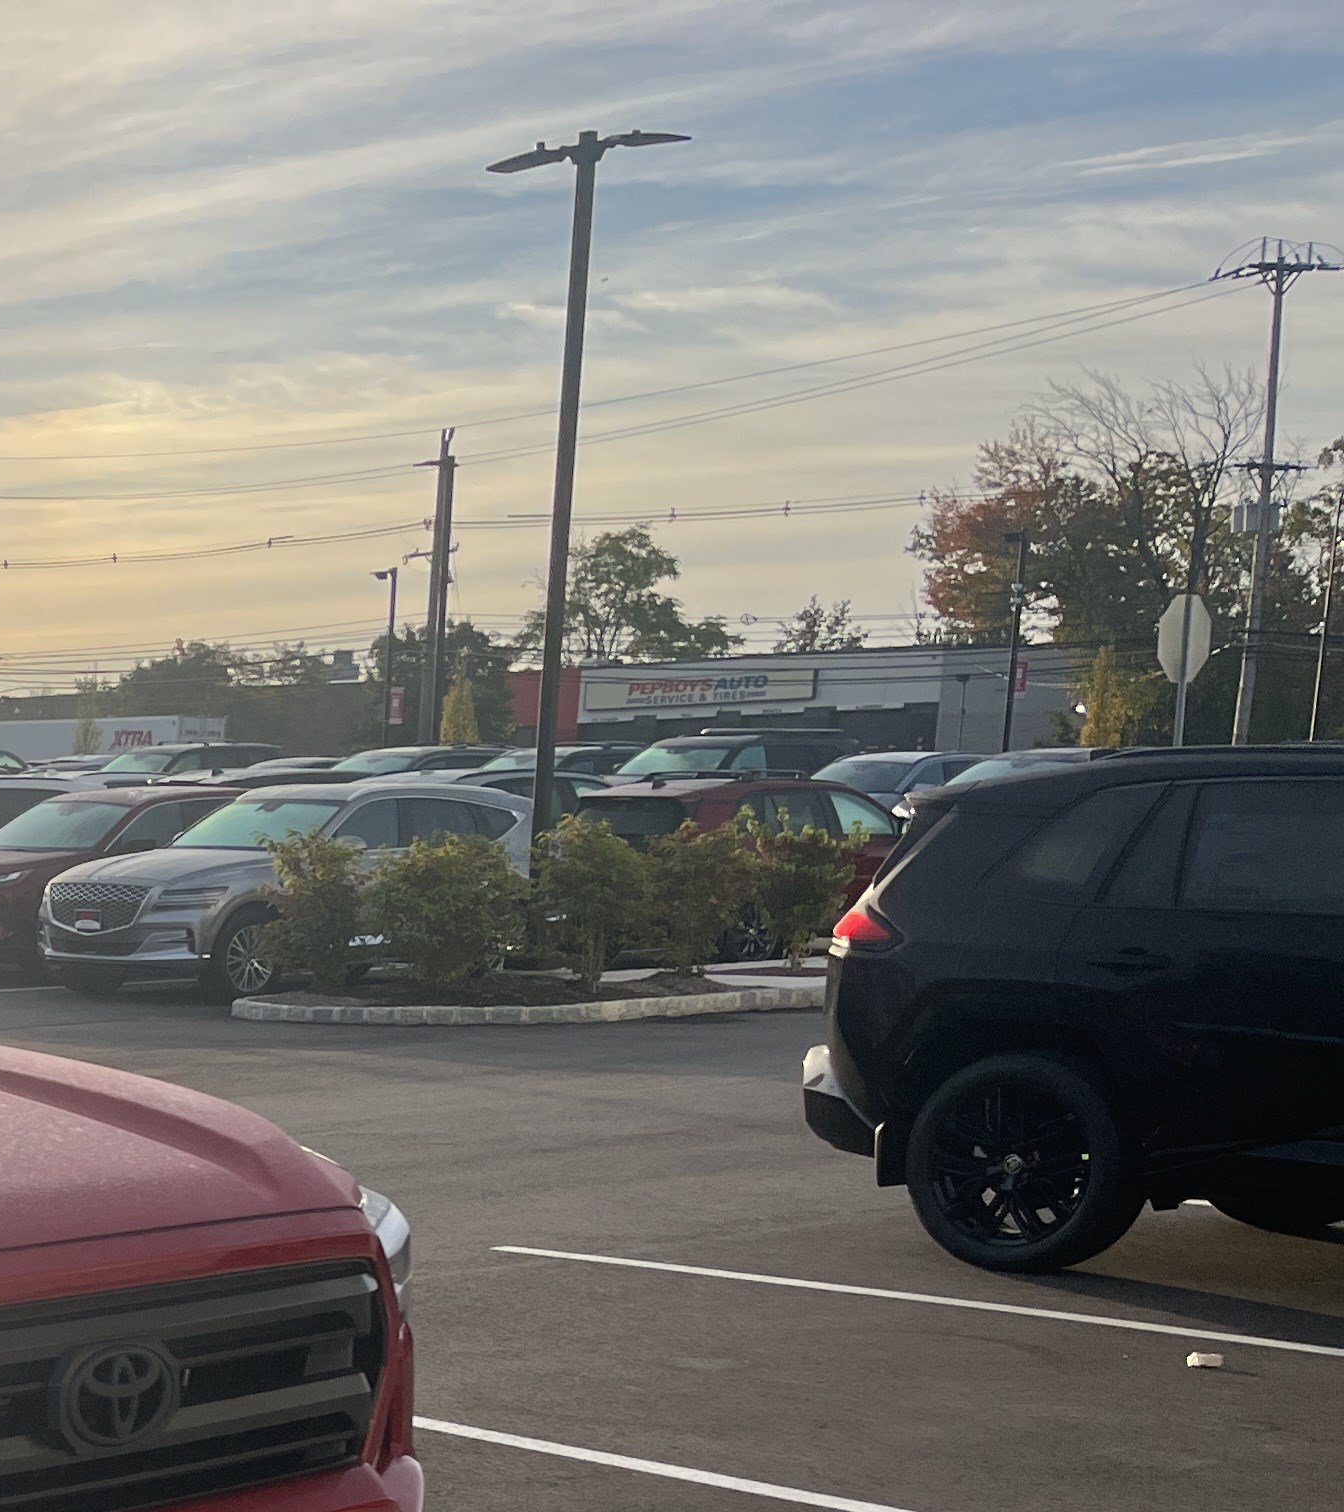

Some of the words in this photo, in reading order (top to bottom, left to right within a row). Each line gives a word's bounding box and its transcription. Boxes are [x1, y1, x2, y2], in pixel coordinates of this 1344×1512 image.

[714, 675, 769, 691] AUTO
[644, 693, 694, 705] SERVICE
[699, 692, 708, 702] &
[713, 690, 746, 701] TIRES
[112, 729, 153, 748] XTRA
